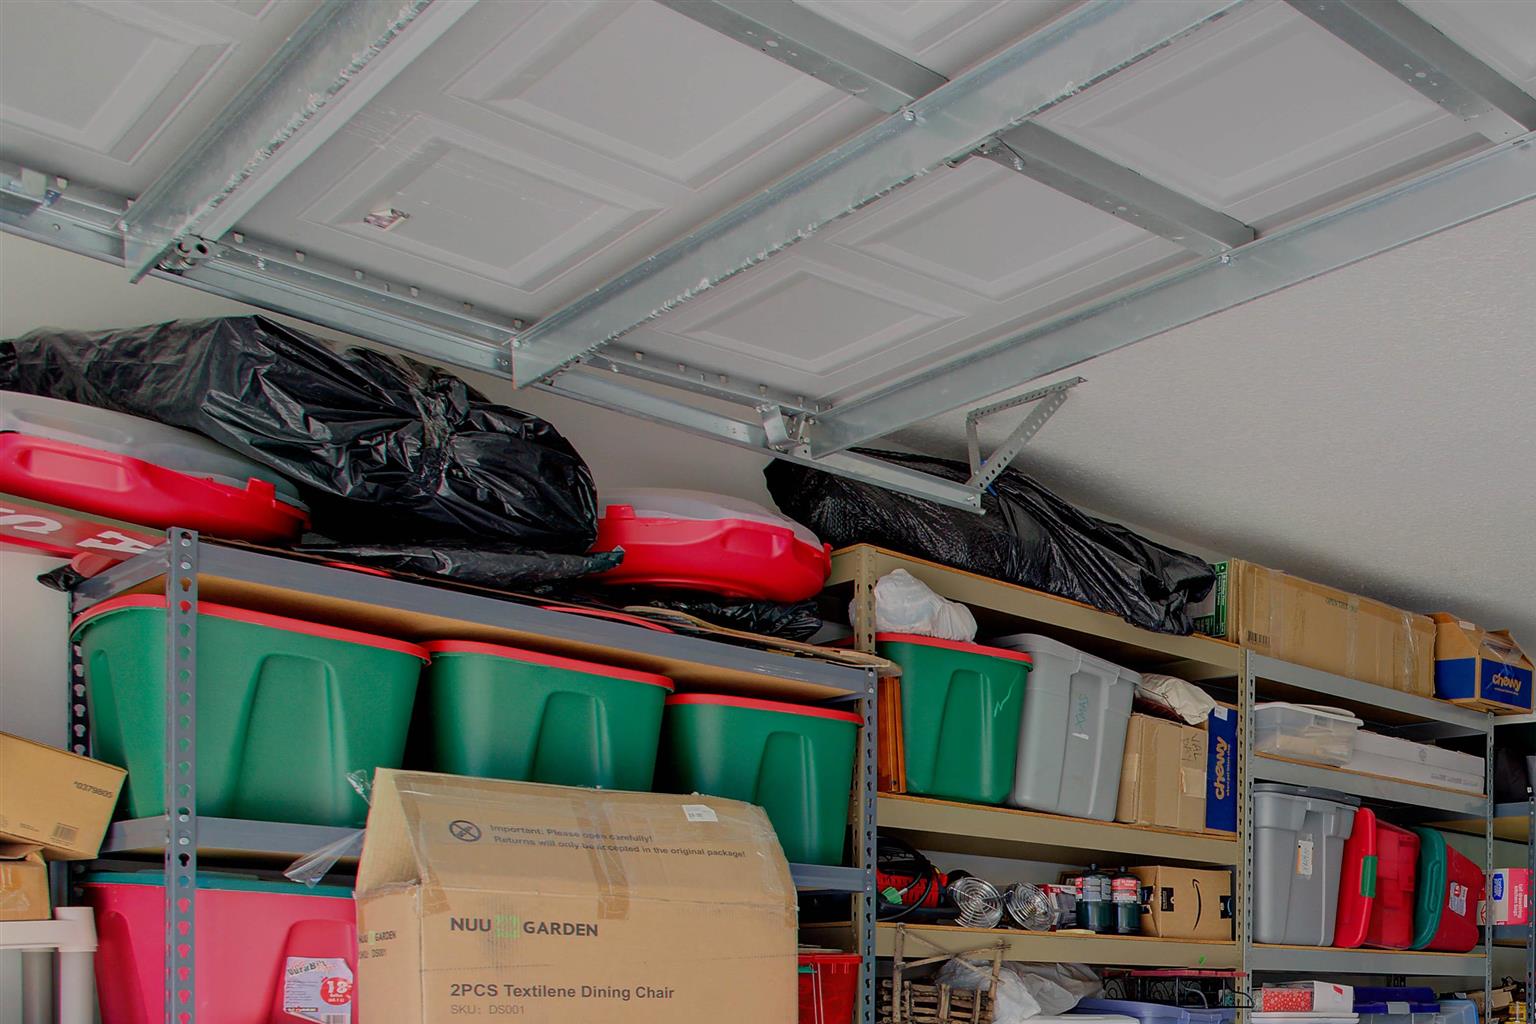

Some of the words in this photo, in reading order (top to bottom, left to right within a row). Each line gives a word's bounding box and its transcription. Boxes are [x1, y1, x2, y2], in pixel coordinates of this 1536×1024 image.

[1493, 674, 1521, 692] chewy
[1215, 736, 1228, 800] chewy
[671, 848, 705, 856] original
[707, 850, 746, 858] package!
[450, 918, 491, 932] NUU
[523, 921, 598, 937] GARDEN
[327, 981, 348, 993] 18
[450, 983, 498, 997] 2PCS
[504, 984, 576, 998] Textilene
[581, 986, 631, 1001] Dining
[635, 986, 675, 999] Chair
[450, 1004, 481, 1015] SKU:
[489, 1004, 524, 1015] DS001
